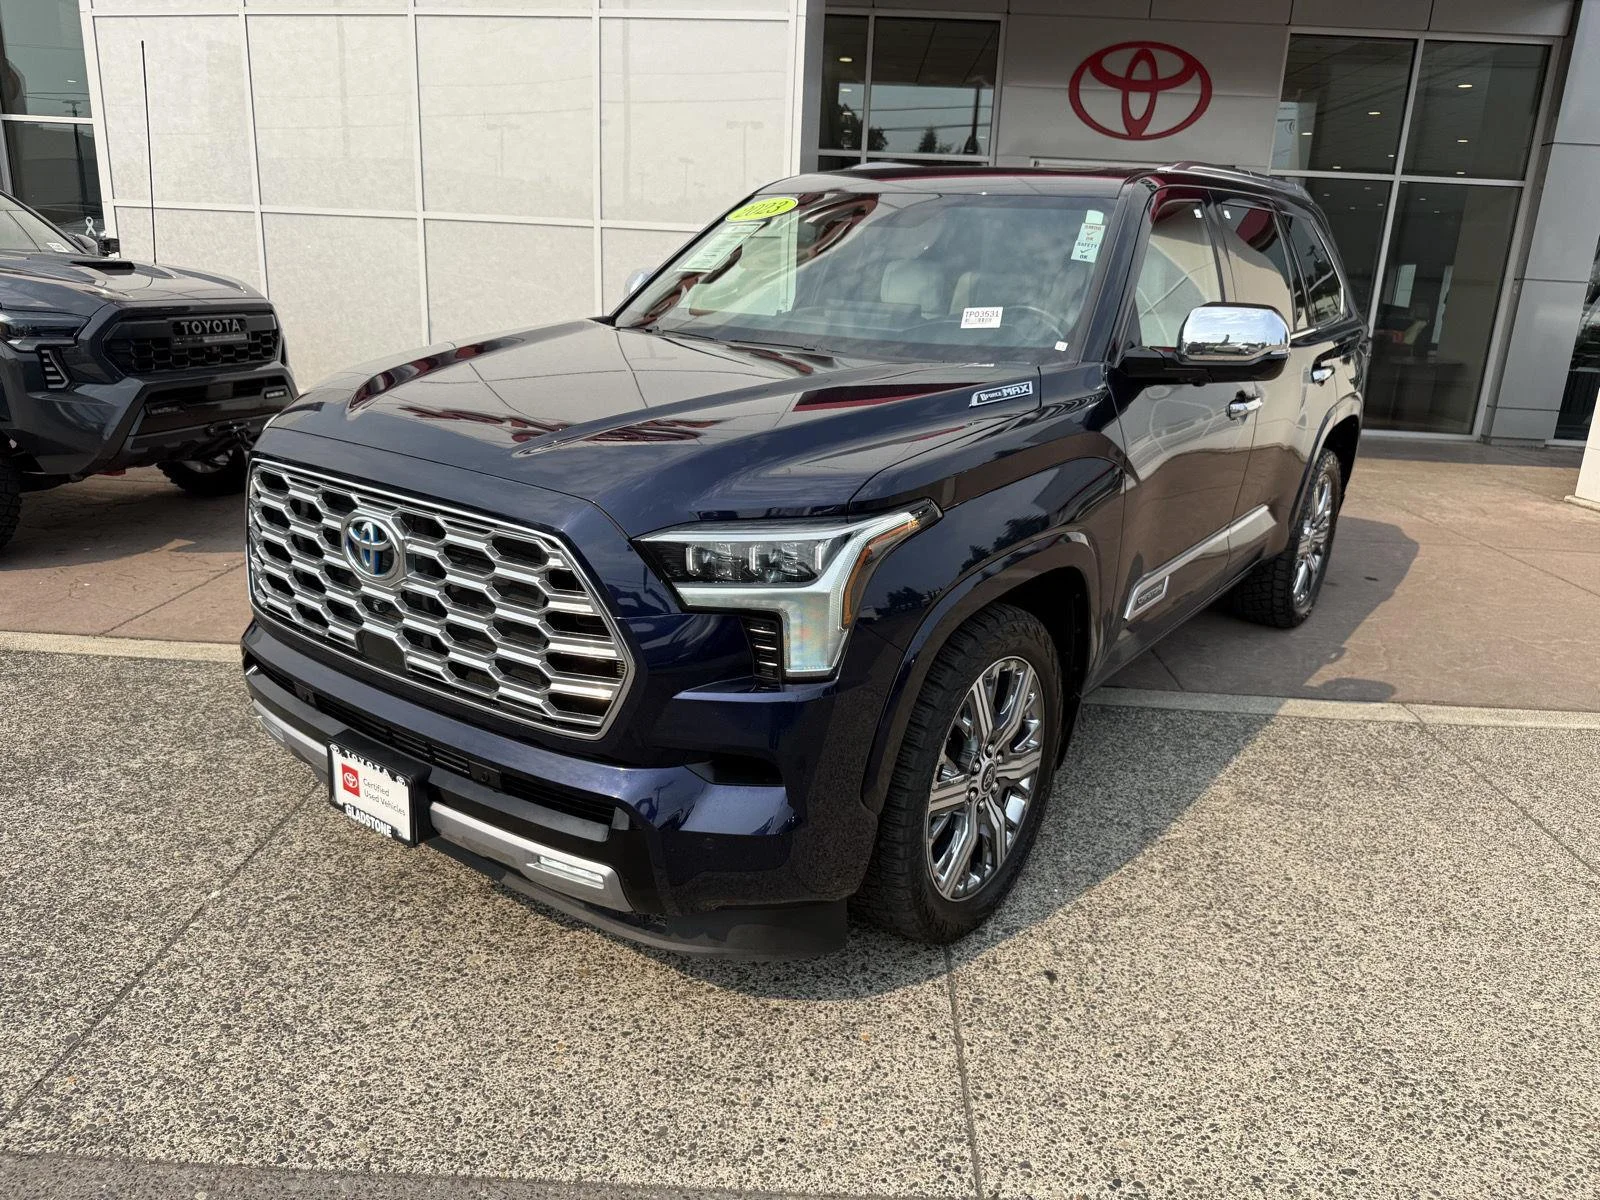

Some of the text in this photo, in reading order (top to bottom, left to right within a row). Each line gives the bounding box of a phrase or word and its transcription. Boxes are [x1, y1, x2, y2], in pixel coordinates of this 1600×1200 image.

[1076, 241, 1098, 249] SAFETY
[181, 319, 241, 335] TOYOTA
[1002, 384, 1029, 397] MAX
[345, 750, 392, 781] TOYOTA
[363, 778, 390, 797] Certified
[364, 788, 406, 816] Used Vehicles
[345, 804, 392, 838] GLADSTONE
